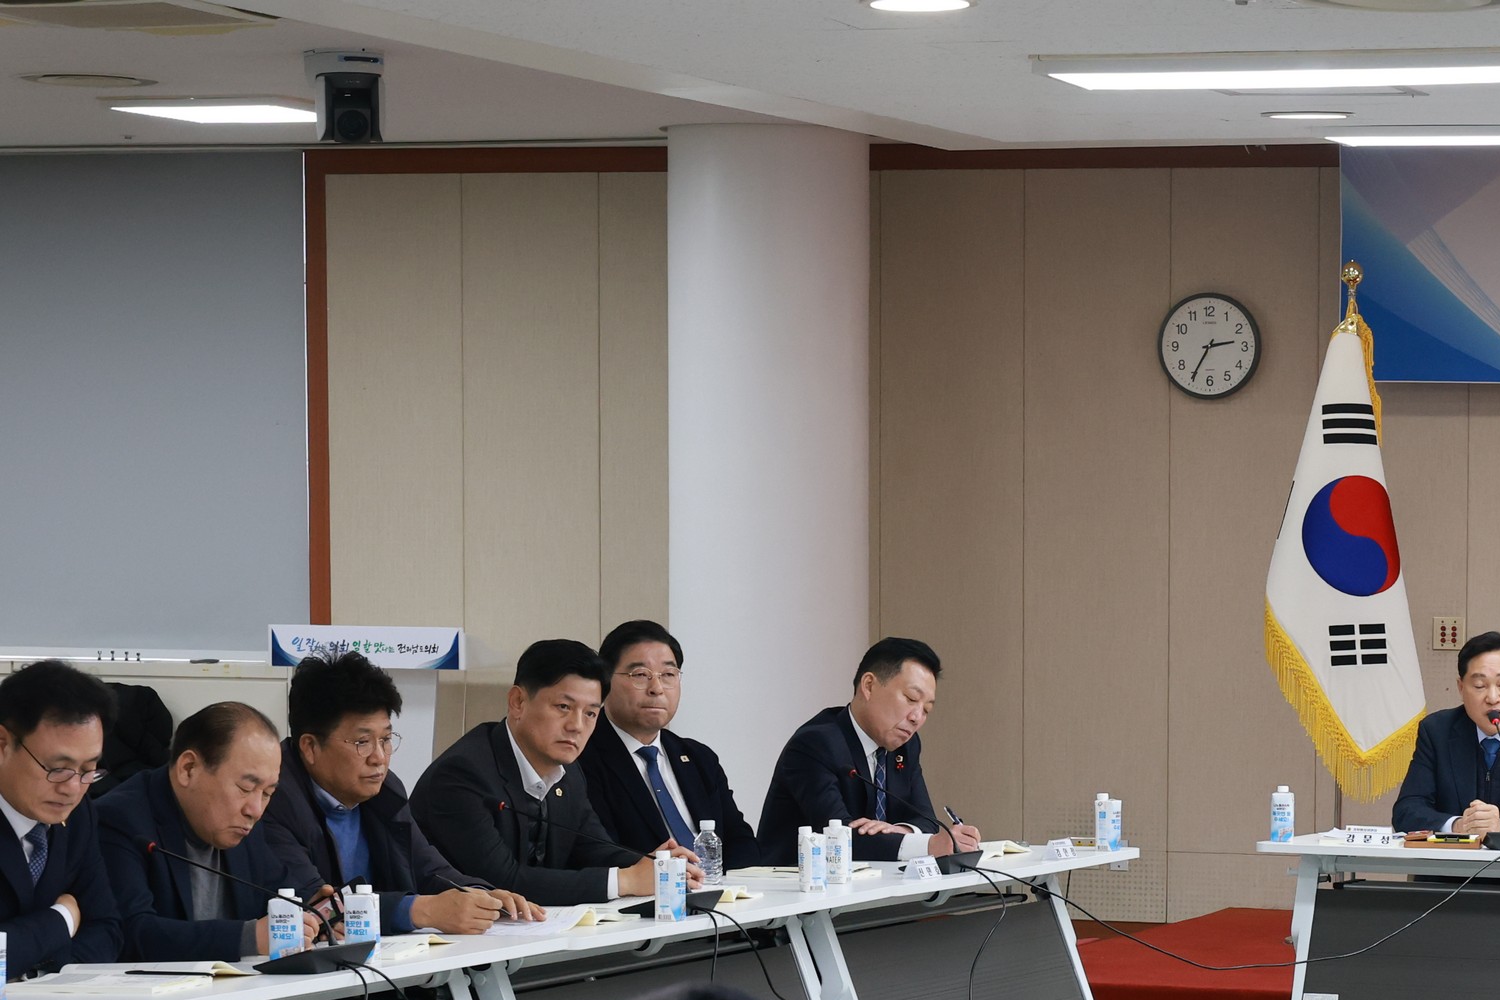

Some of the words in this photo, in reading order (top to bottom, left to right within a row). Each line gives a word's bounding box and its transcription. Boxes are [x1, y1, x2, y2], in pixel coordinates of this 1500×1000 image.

[1188, 310, 1197, 321] 11
[1203, 305, 1215, 317] 12
[1224, 311, 1229, 322] 1
[1176, 323, 1188, 335] 10
[1235, 323, 1243, 334] 2
[1171, 341, 1179, 352] 9
[1241, 341, 1249, 352] 3
[1178, 359, 1186, 370] 8
[1235, 360, 1243, 370] 4
[1206, 375, 1214, 387] 6
[1223, 371, 1231, 381] 5
